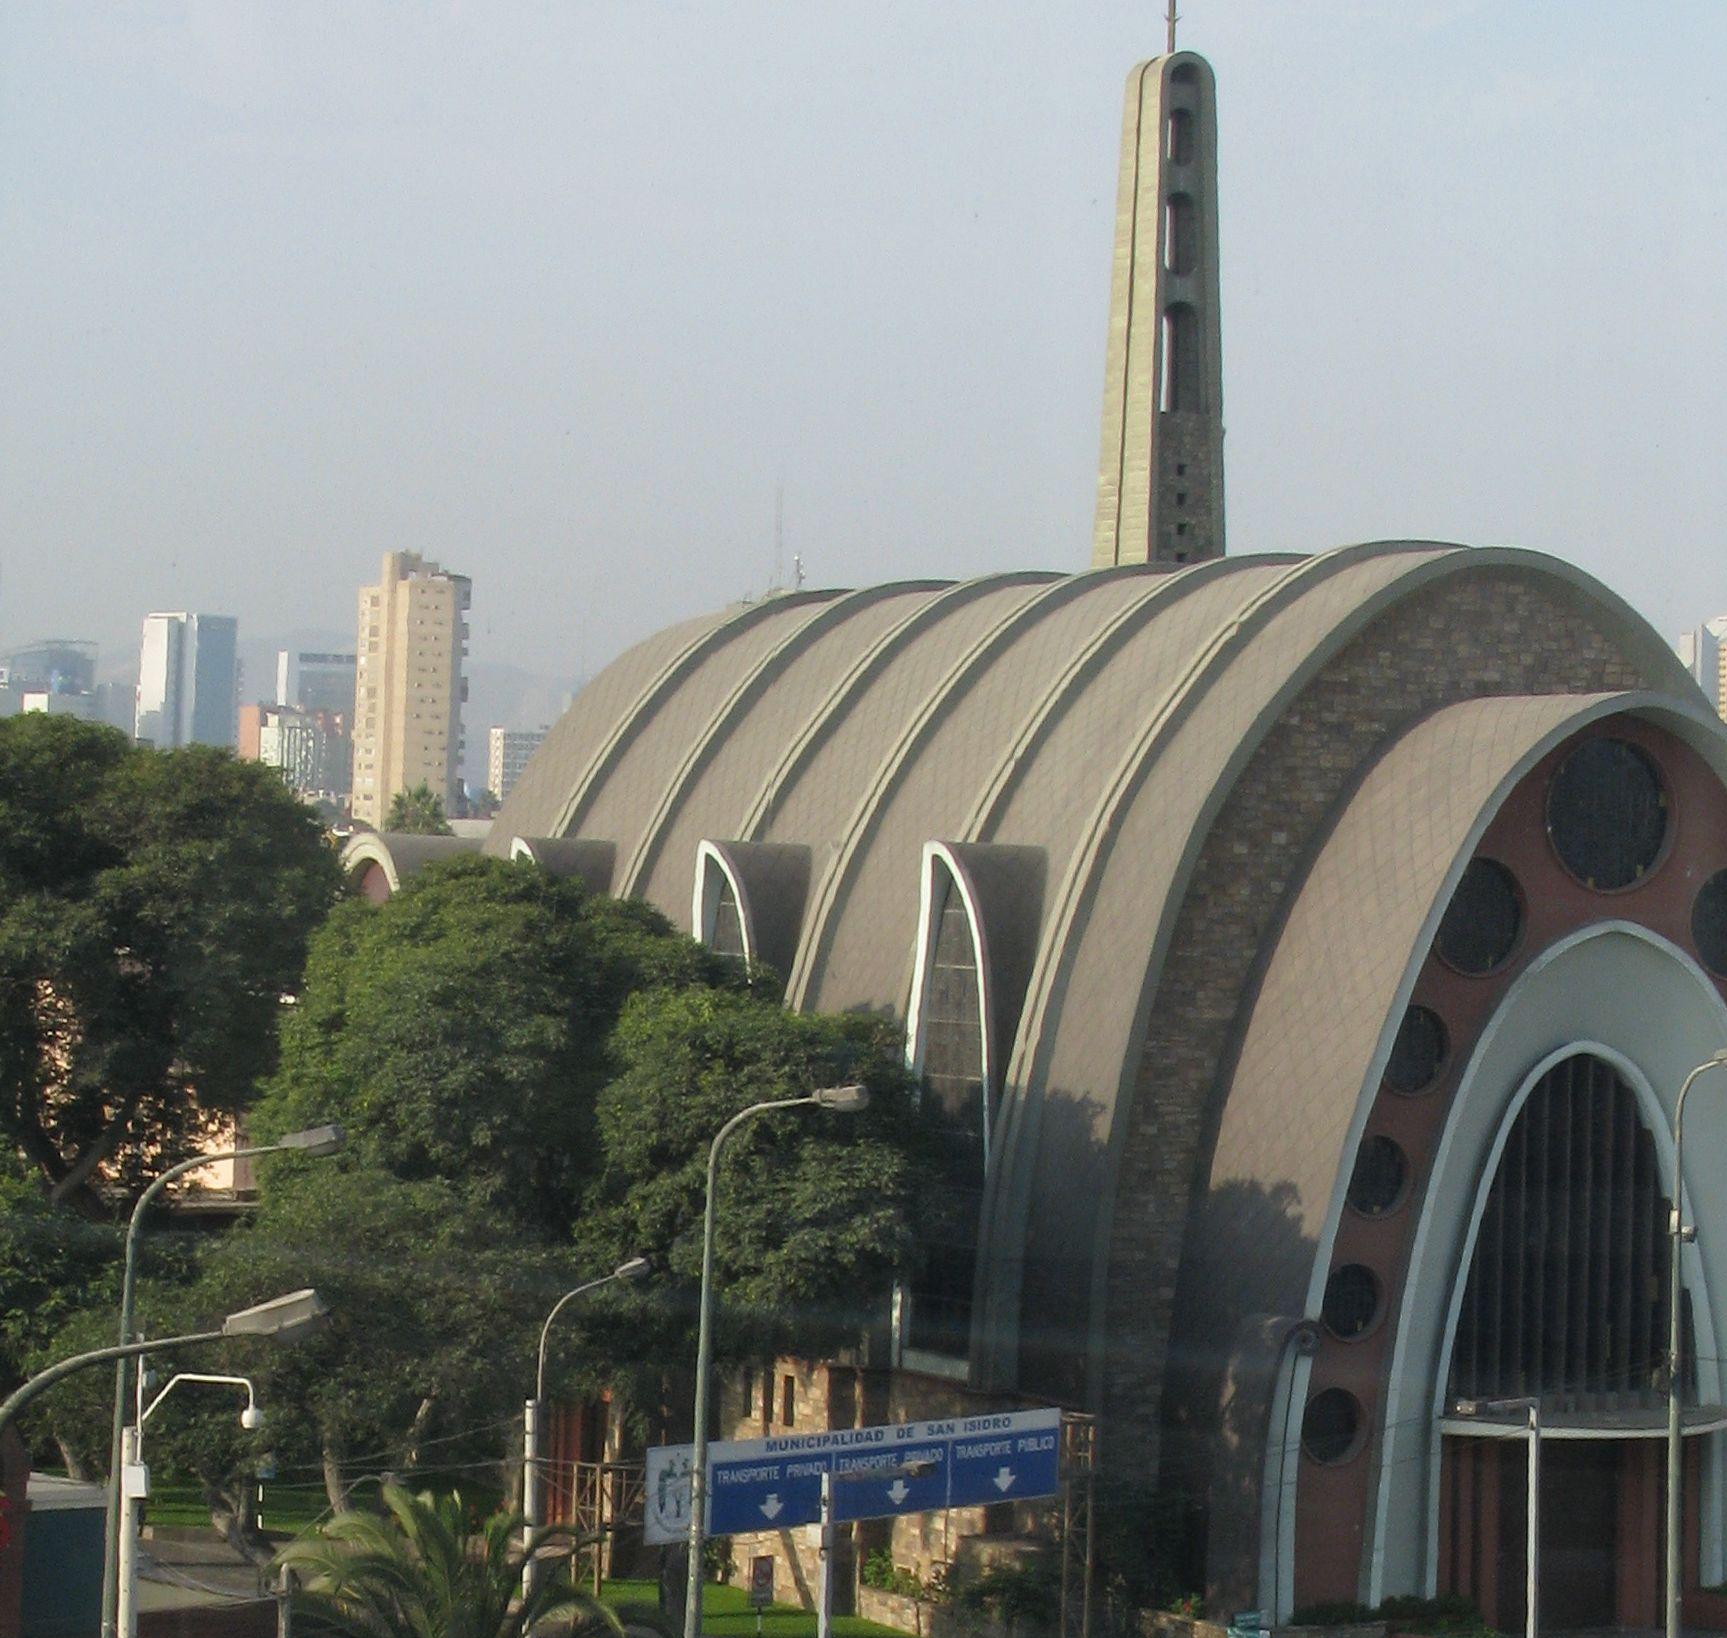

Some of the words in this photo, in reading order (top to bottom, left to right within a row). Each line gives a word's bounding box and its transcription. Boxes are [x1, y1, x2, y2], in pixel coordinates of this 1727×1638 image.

[766, 1430, 884, 1452] MUNICIPALIDAD
[896, 1426, 914, 1440] DE
[928, 1423, 955, 1436] SAN
[964, 1416, 1012, 1433] ISIDRO
[955, 1440, 1012, 1459] TRANSPORTE
[717, 1465, 780, 1485] TRANSPORTE
[786, 1461, 828, 1479] PRIVADO
[839, 1452, 898, 1473] TRANSPORTE
